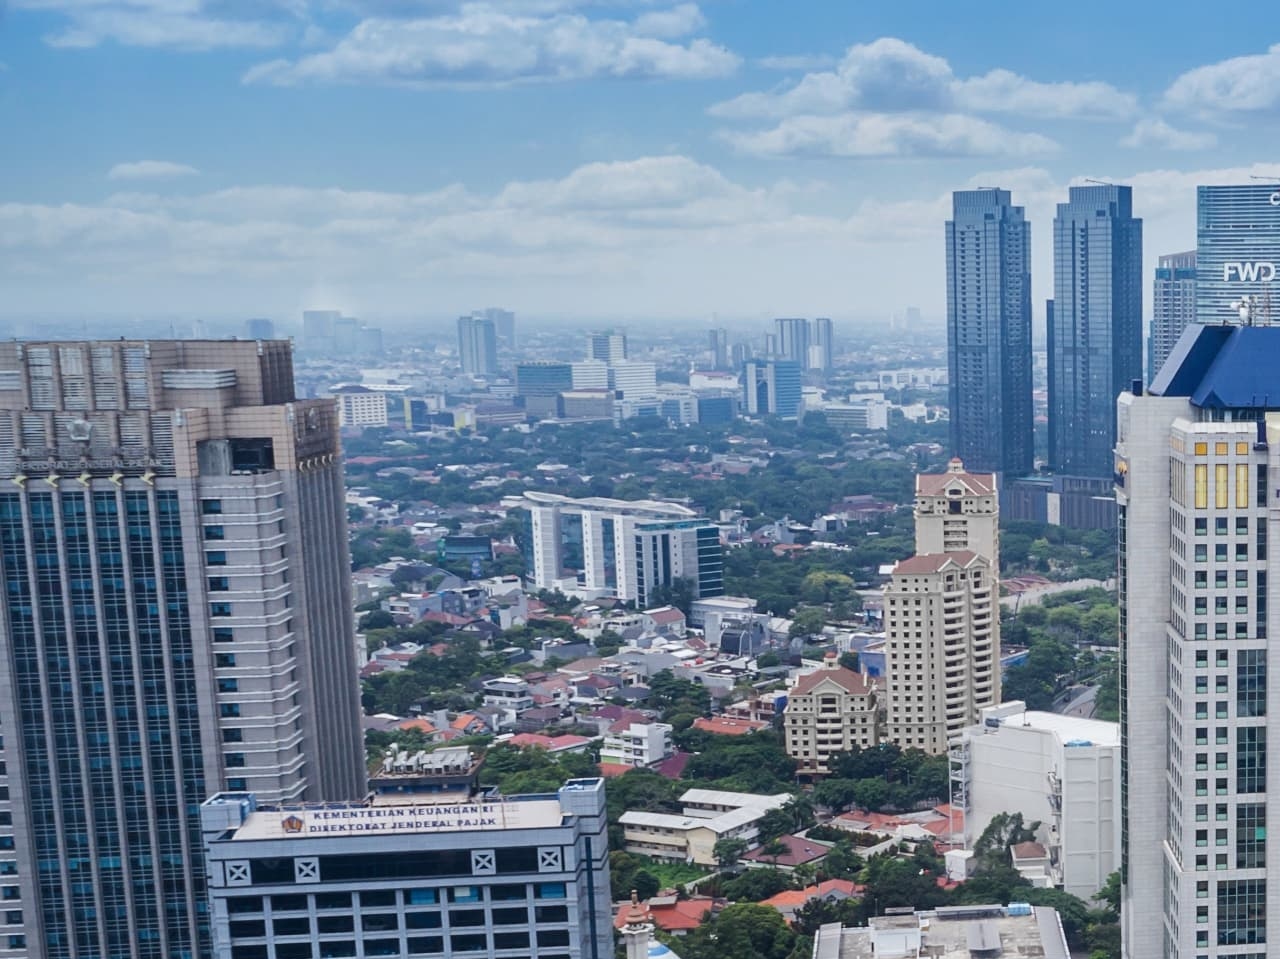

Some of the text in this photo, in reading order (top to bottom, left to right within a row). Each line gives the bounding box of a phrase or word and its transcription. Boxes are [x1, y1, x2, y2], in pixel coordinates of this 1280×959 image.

[1223, 261, 1277, 282] FWD
[313, 805, 494, 820] KEMENTERIAN KEUANGAN RI
[310, 818, 496, 833] DIREKTORAT JENDERAL PAJAK
